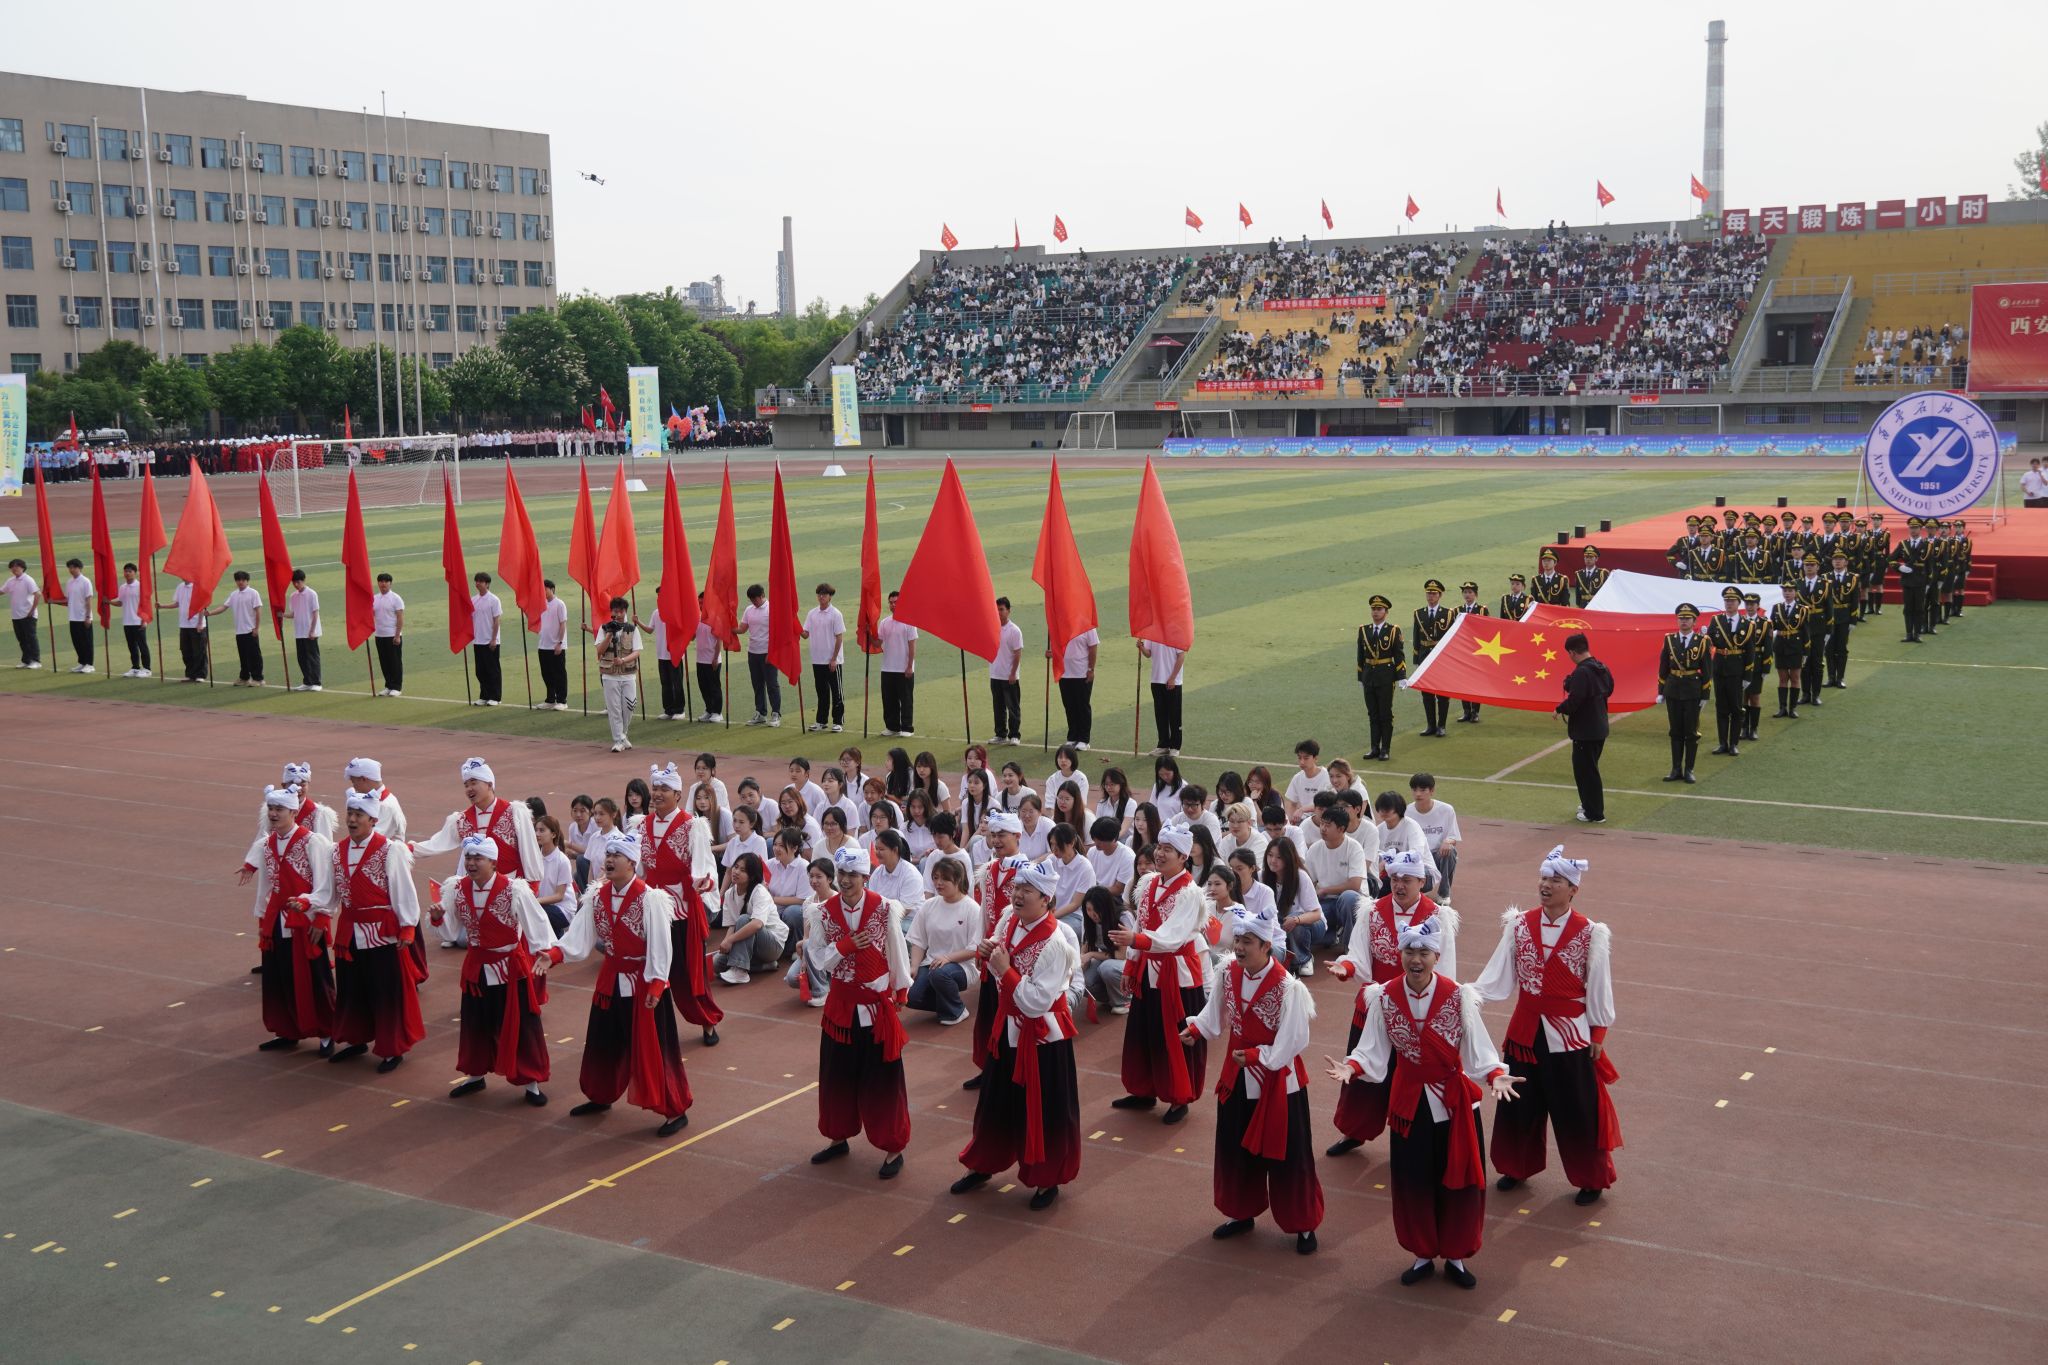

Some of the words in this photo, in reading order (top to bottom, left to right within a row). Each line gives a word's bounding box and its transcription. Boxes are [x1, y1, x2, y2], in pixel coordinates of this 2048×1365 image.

[1726, 198, 1985, 232] 每天锻炼一小时
[1873, 454, 1889, 485] XI'AN
[1888, 487, 1932, 510] SHIYOU
[1939, 454, 1989, 509] UNIVERSITY
[1920, 482, 1940, 490] 1951
